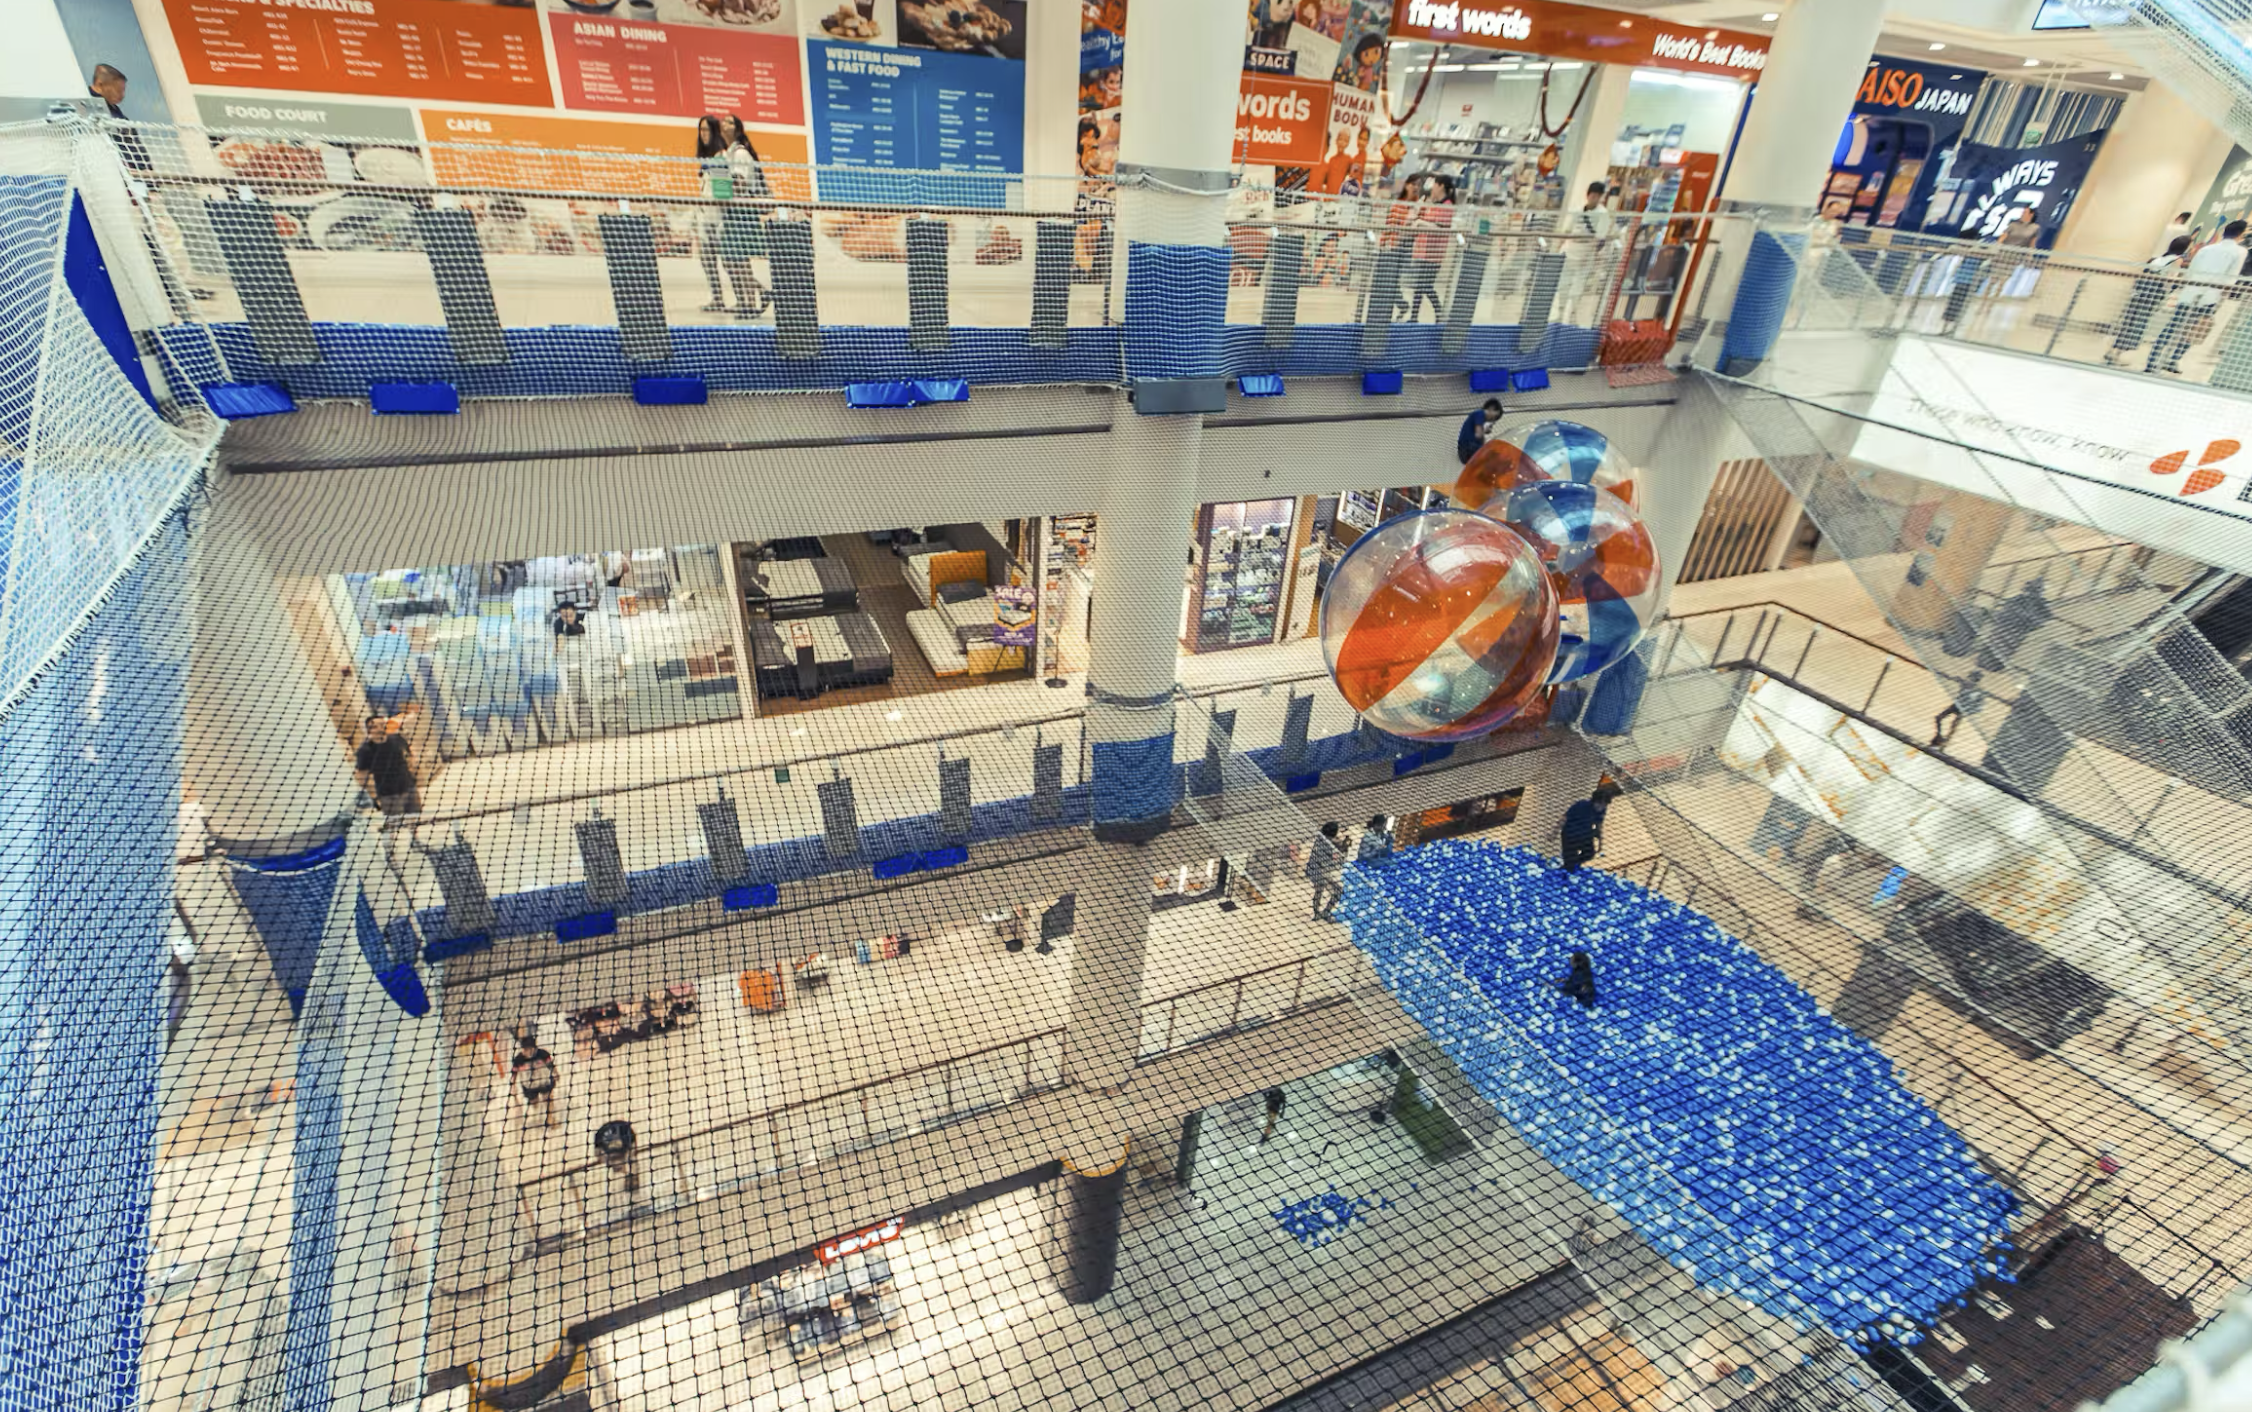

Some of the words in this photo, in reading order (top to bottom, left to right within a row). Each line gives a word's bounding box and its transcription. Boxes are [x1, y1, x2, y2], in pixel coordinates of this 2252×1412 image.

[274, 0, 375, 15] SPECIALTIES
[1408, 0, 1459, 31] first
[1462, 8, 1531, 40] words
[574, 20, 615, 38] ASIAN
[620, 26, 667, 43] DINING
[825, 46, 881, 63] WESTERN
[882, 53, 922, 67] DINING
[1652, 33, 1701, 61] World's
[1698, 41, 1732, 65] Best
[826, 60, 836, 71] &
[837, 60, 868, 74] FAST
[868, 64, 901, 78] FOOD
[1249, 52, 1290, 69] SPACE
[1914, 88, 1973, 115] JAPAN
[224, 105, 272, 121] FOOD
[276, 107, 328, 123] COURT
[1333, 109, 1369, 128] BODY
[446, 118, 492, 133] CAFÉS
[1252, 125, 1292, 145] books
